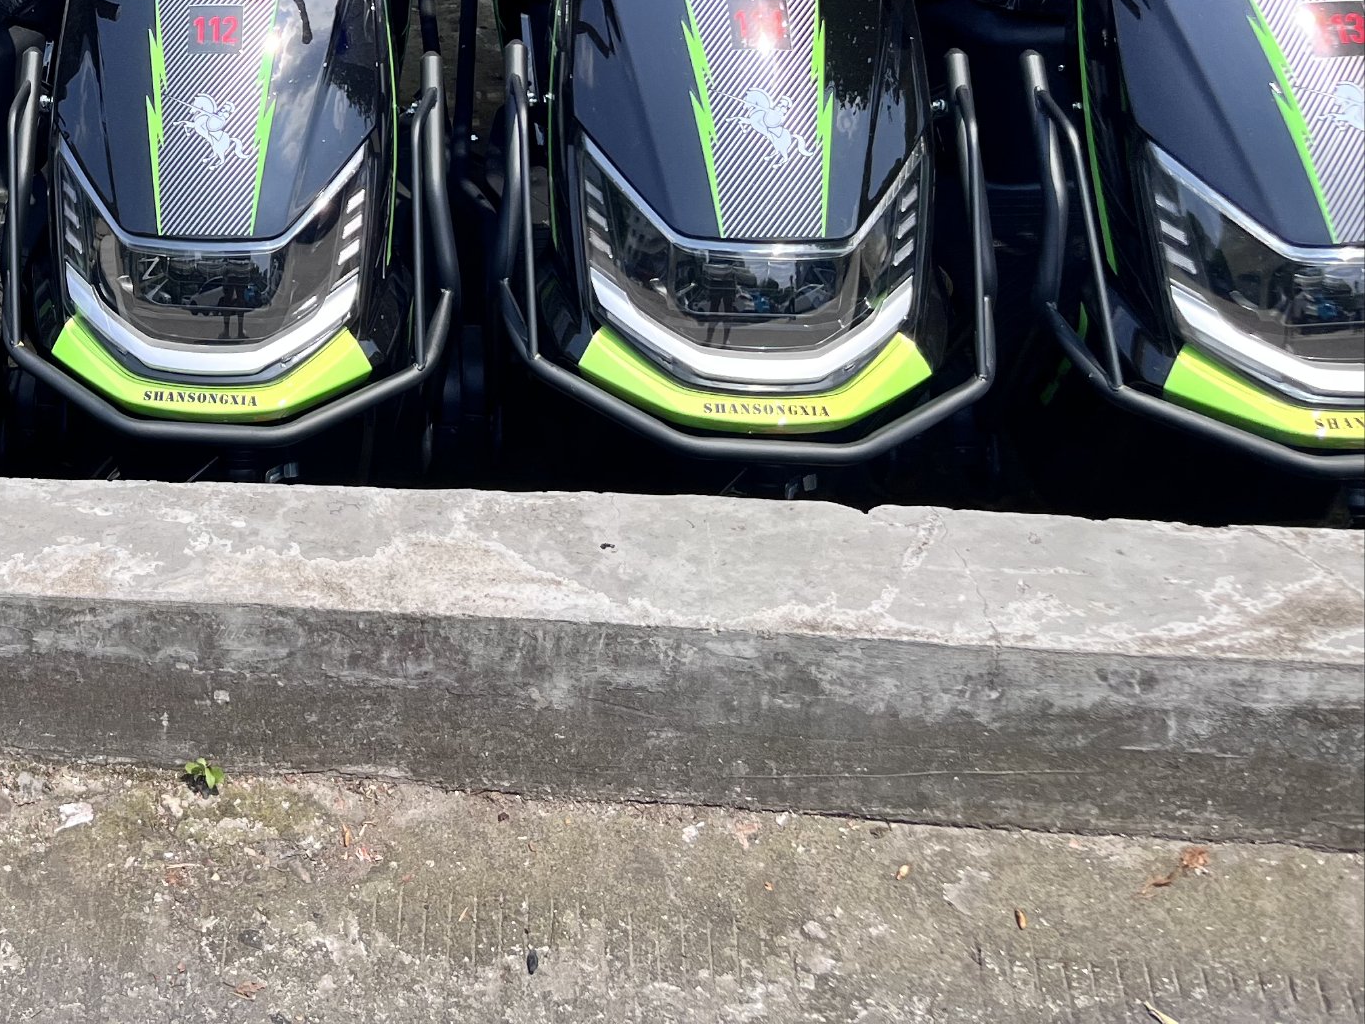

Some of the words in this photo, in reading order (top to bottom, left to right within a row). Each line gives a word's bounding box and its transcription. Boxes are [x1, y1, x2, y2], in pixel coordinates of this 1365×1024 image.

[193, 16, 240, 44] 112
[143, 390, 258, 406] SHANSONGXIA
[703, 403, 830, 417] SHANSONGXIA
